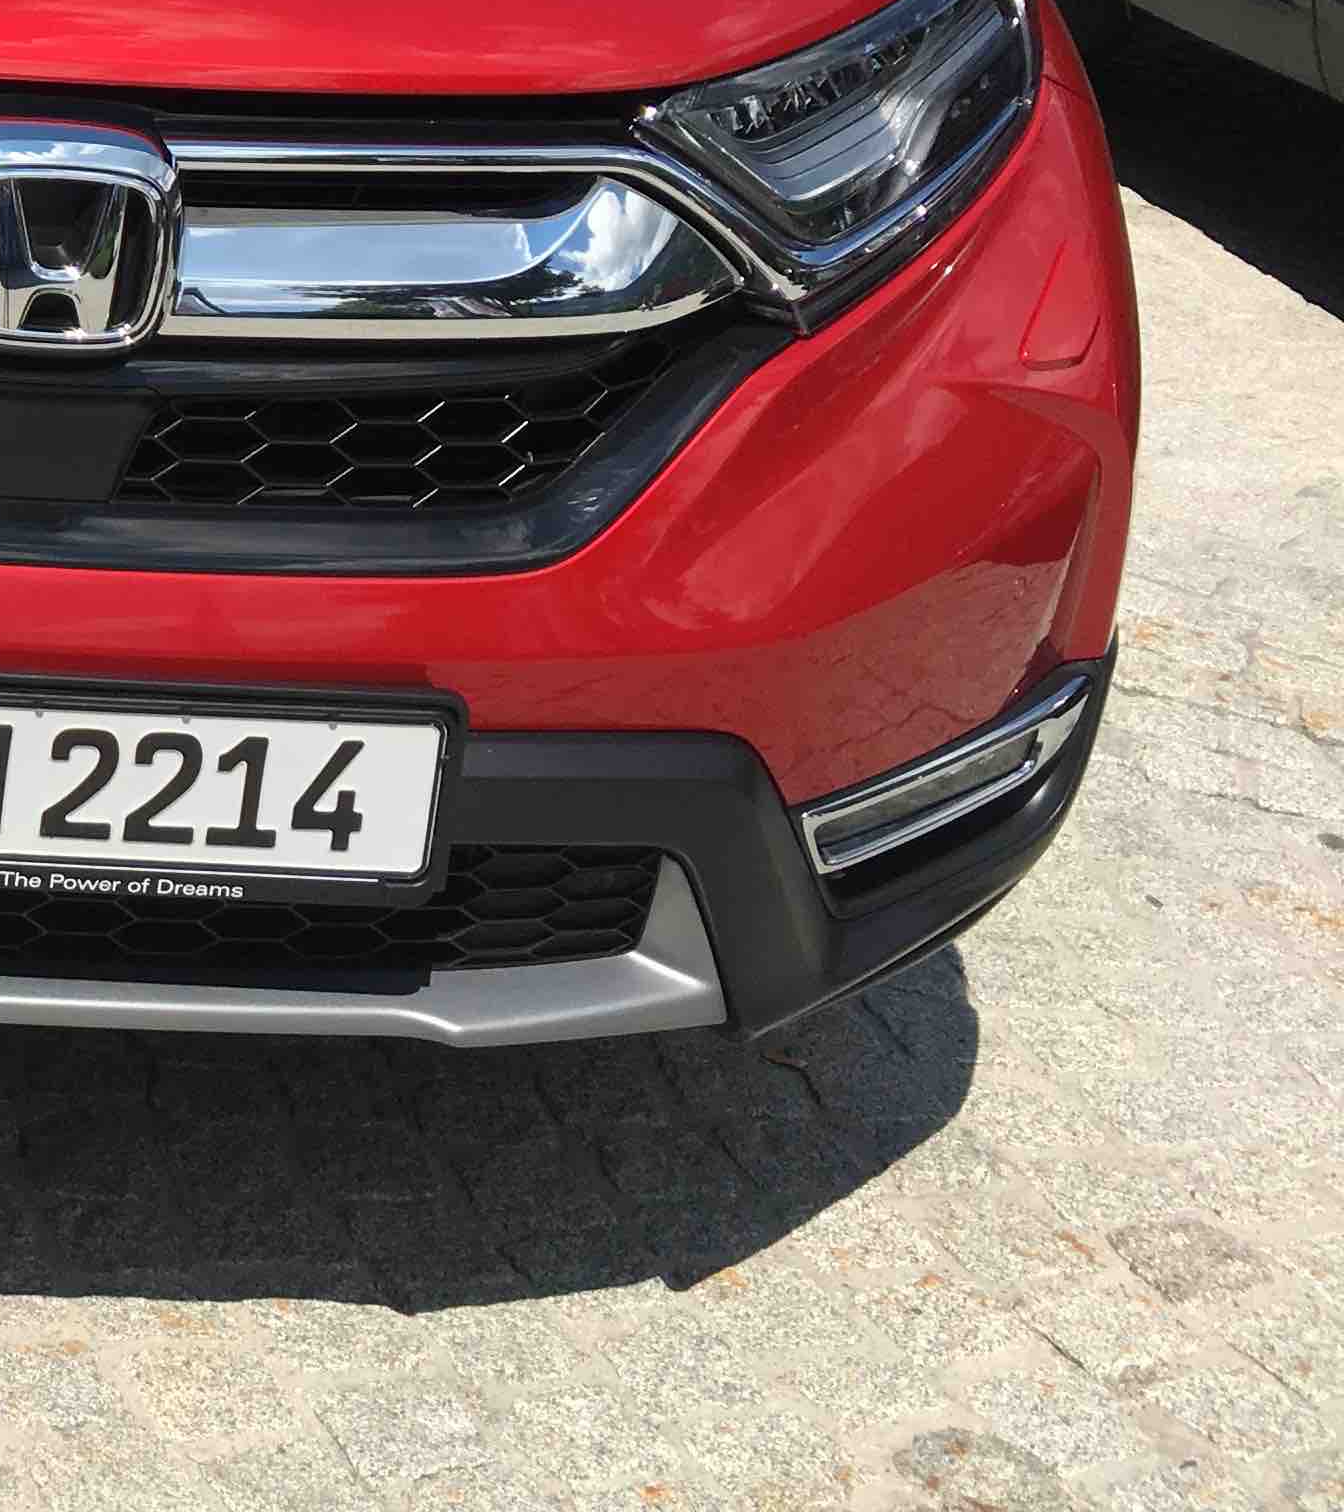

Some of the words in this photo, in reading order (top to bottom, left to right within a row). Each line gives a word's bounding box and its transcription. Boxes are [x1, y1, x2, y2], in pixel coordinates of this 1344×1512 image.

[0, 870, 42, 889] The
[49, 873, 121, 893] Power
[127, 878, 150, 894] of
[157, 879, 244, 899] Dreams
